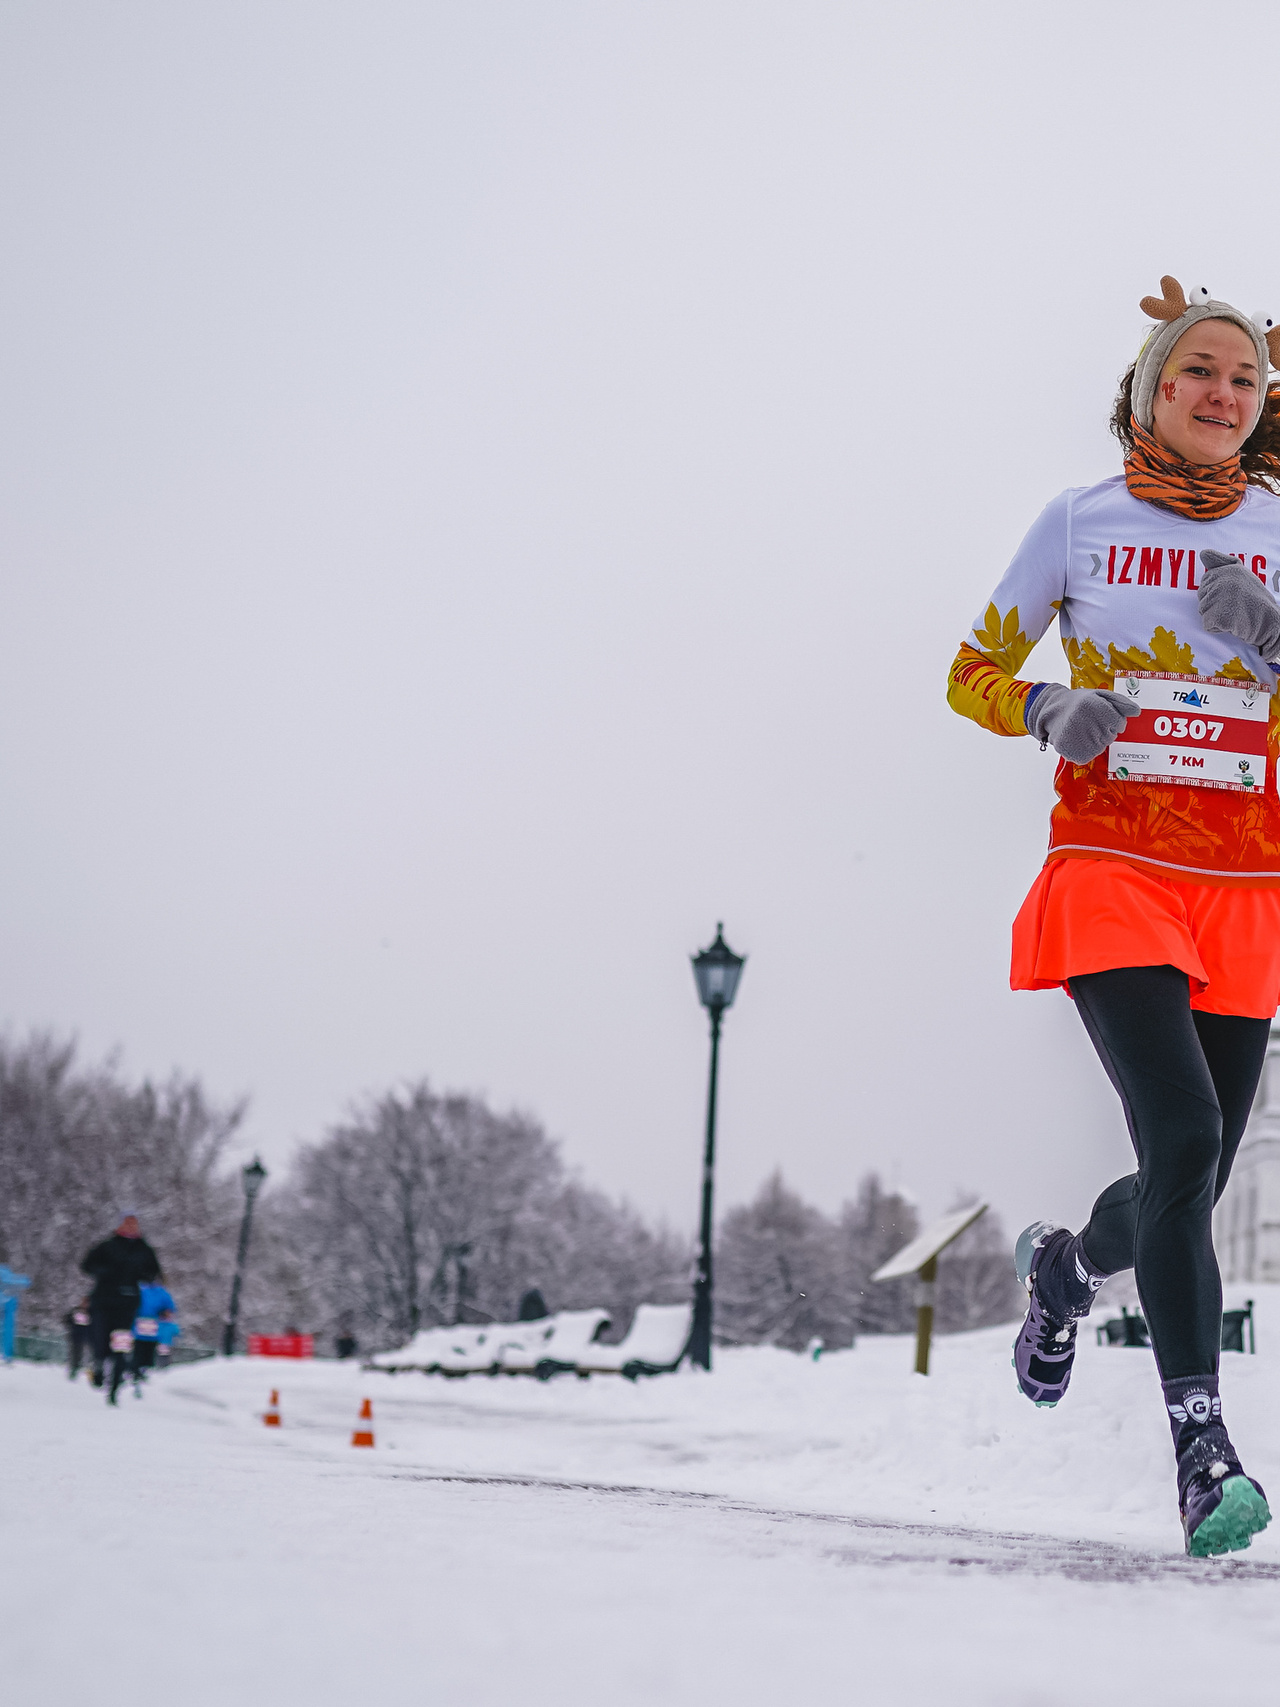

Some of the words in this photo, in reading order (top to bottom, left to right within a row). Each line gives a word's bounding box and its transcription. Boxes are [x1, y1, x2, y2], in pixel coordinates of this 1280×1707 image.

[1107, 545, 1267, 591] IZMYLG
[1172, 689, 1210, 708] TRAIL
[1153, 715, 1224, 742] 0307
[1168, 754, 1178, 765] 7
[1181, 755, 1205, 768] KM
[1193, 1401, 1206, 1414] G
